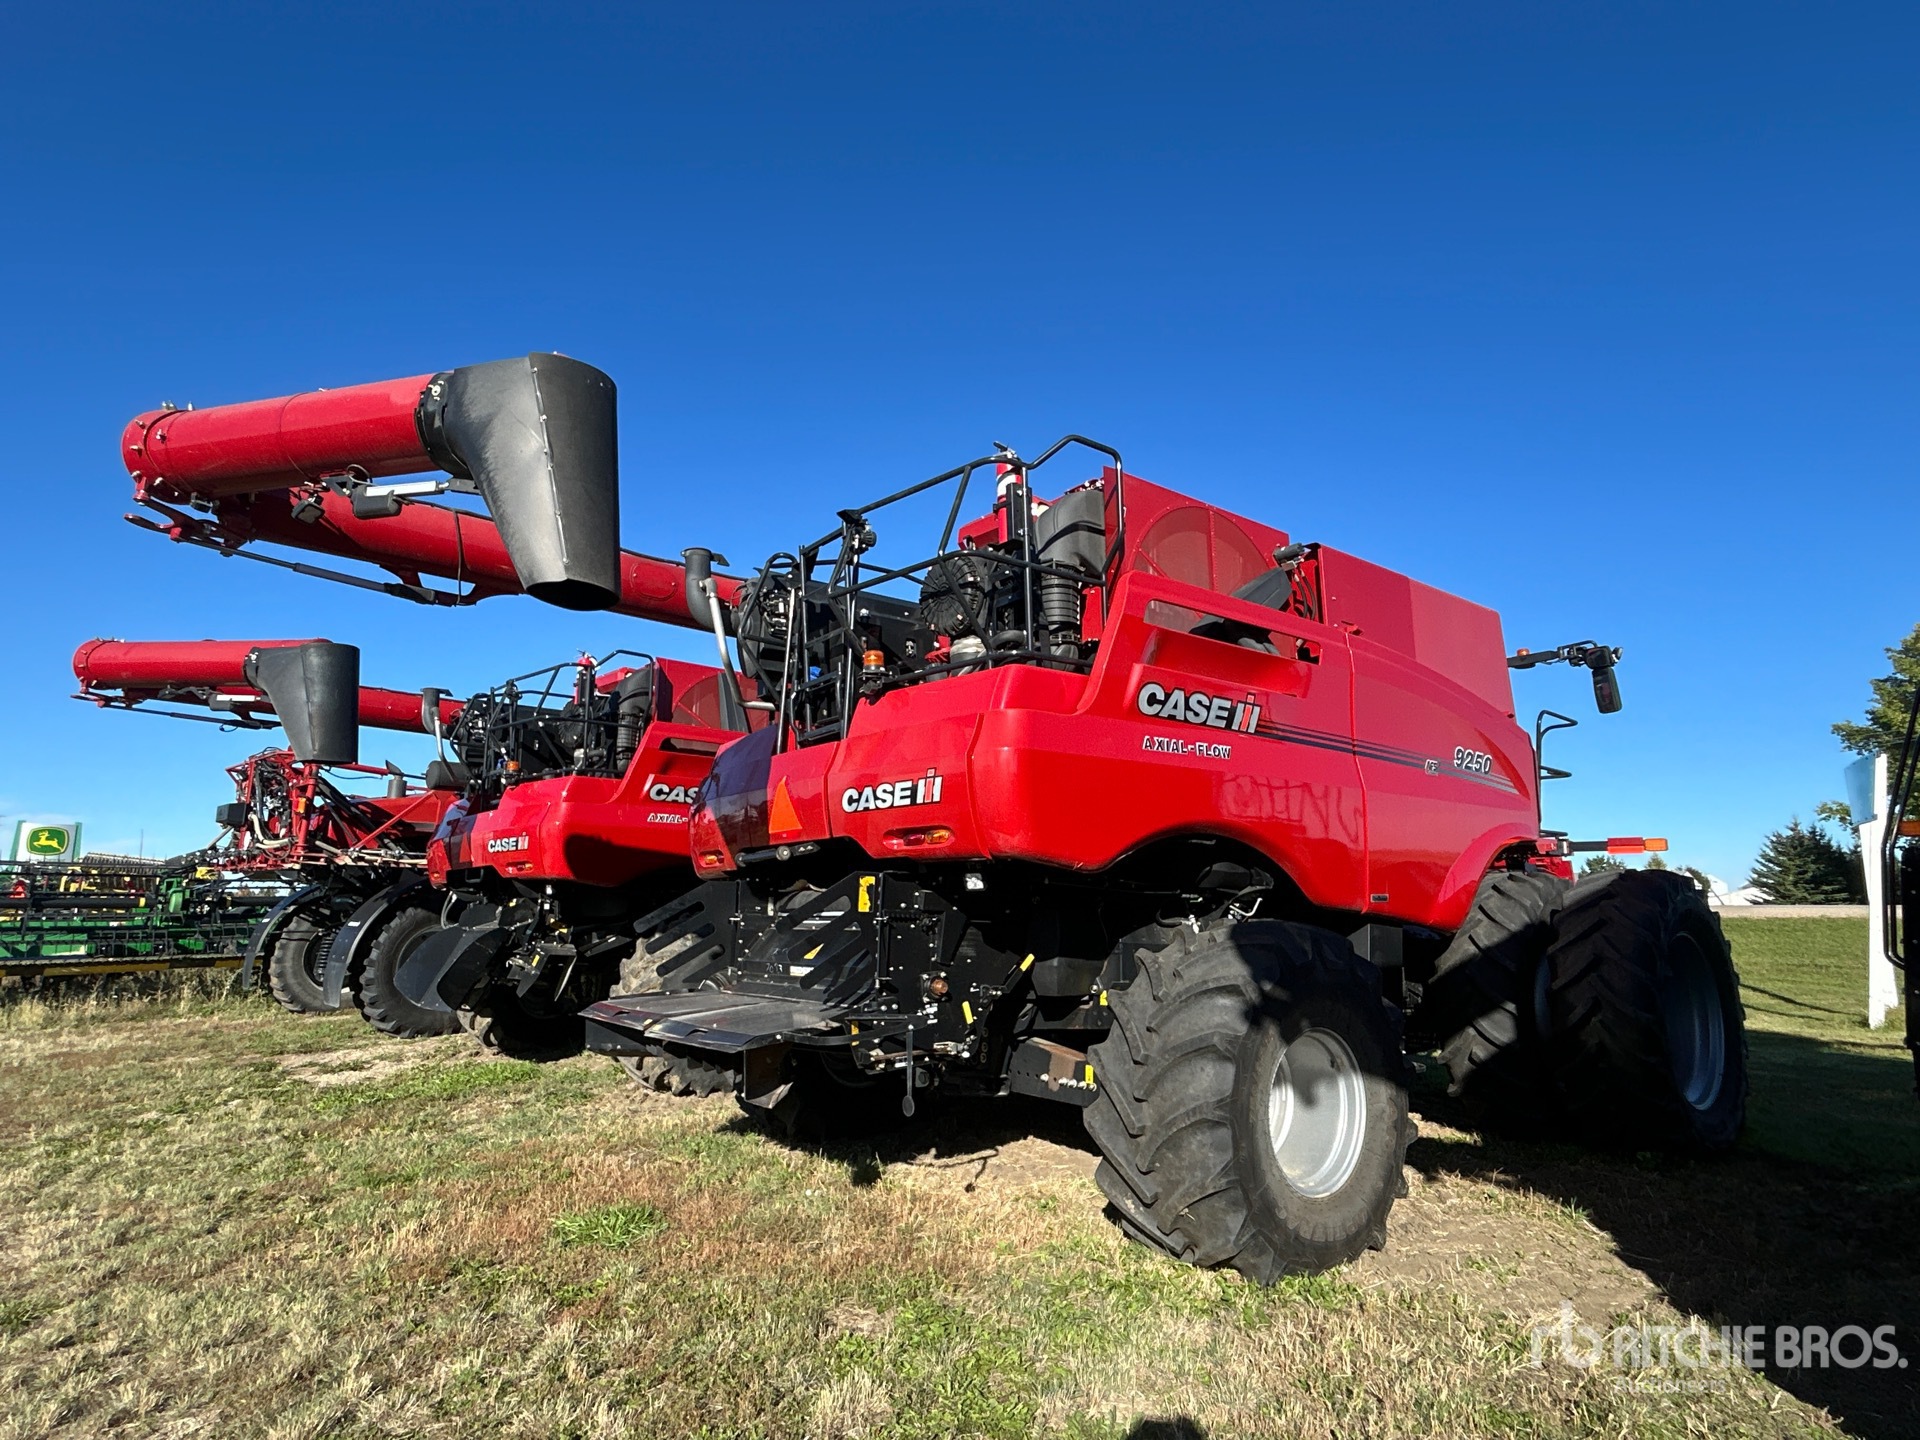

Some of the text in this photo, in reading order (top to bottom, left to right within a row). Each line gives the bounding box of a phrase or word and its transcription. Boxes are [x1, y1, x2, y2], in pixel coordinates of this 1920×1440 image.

[1137, 682, 1232, 729] CASE
[1141, 735, 1232, 760] AXIAL-FLOW
[1453, 745, 1493, 775] 9250
[649, 783, 700, 804] CAS
[841, 779, 914, 813] CASE
[646, 812, 689, 824] AXIAL-
[487, 836, 518, 853] CASE
